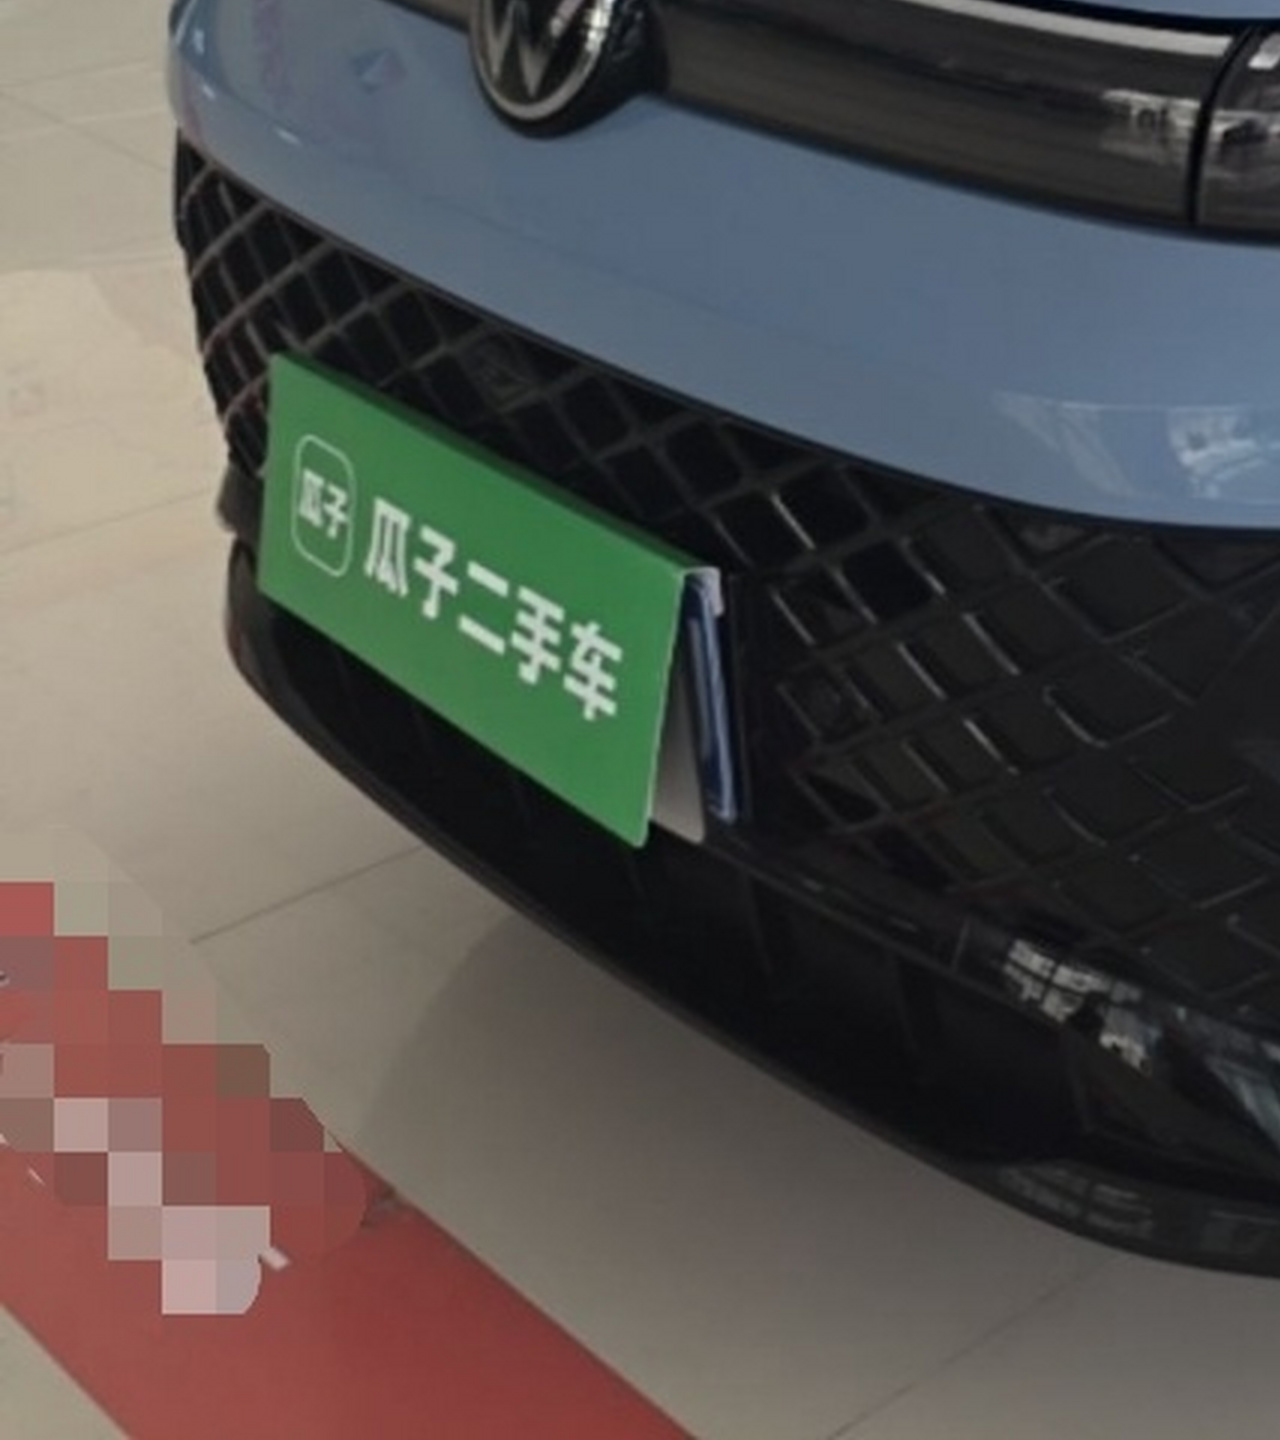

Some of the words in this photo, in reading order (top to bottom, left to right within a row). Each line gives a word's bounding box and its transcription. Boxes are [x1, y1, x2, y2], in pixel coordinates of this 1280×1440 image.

[299, 469, 351, 540] 瓜子
[363, 496, 623, 722] 瓜子二手车
